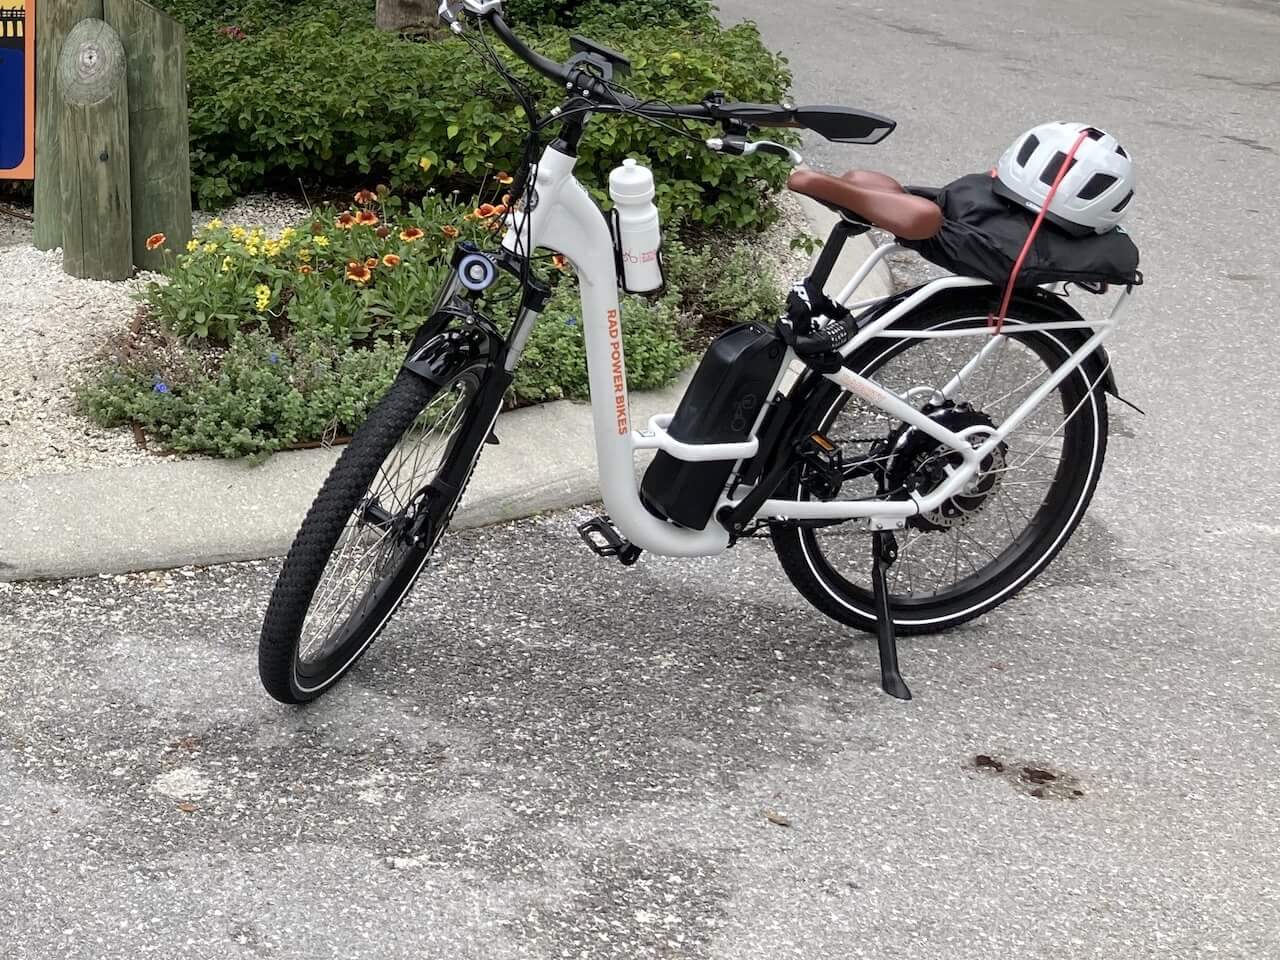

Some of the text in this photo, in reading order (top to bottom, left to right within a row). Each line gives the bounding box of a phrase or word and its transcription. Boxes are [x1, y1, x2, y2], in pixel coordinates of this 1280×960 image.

[607, 309, 628, 436] RAD POWER BIKES
